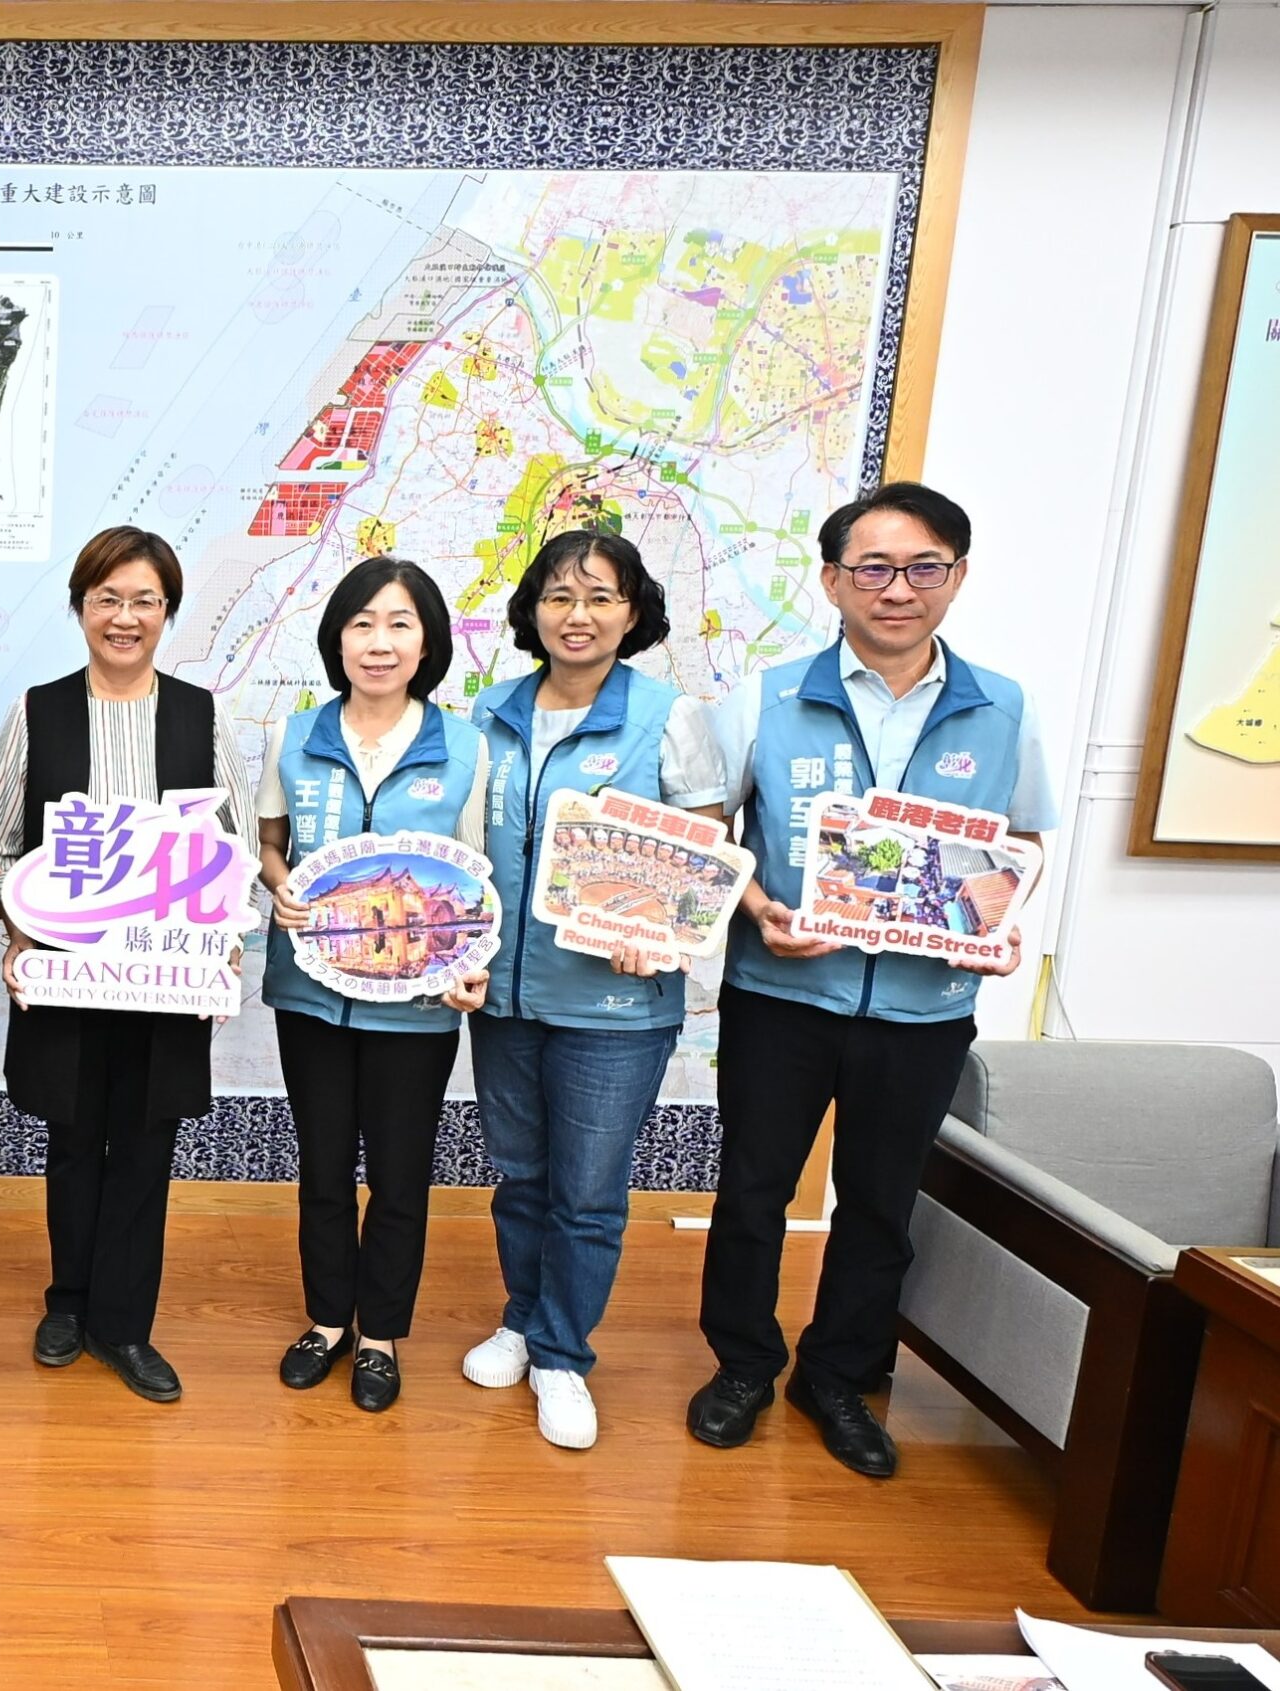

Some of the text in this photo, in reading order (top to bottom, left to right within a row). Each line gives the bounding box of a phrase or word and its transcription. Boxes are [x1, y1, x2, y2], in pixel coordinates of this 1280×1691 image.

[50, 231, 61, 240] 10
[600, 795, 719, 848] 扇形車庫
[867, 796, 1000, 843] 鹿港老街
[49, 800, 232, 925] 彰化
[124, 926, 229, 957] 縣政府
[577, 911, 667, 943] Changhua
[798, 916, 1003, 959] Lukang Old Street
[563, 929, 673, 965] Roundse
[20, 957, 232, 990] CHANGHUA
[23, 984, 232, 1009] COUNTY GOVERNMENT
